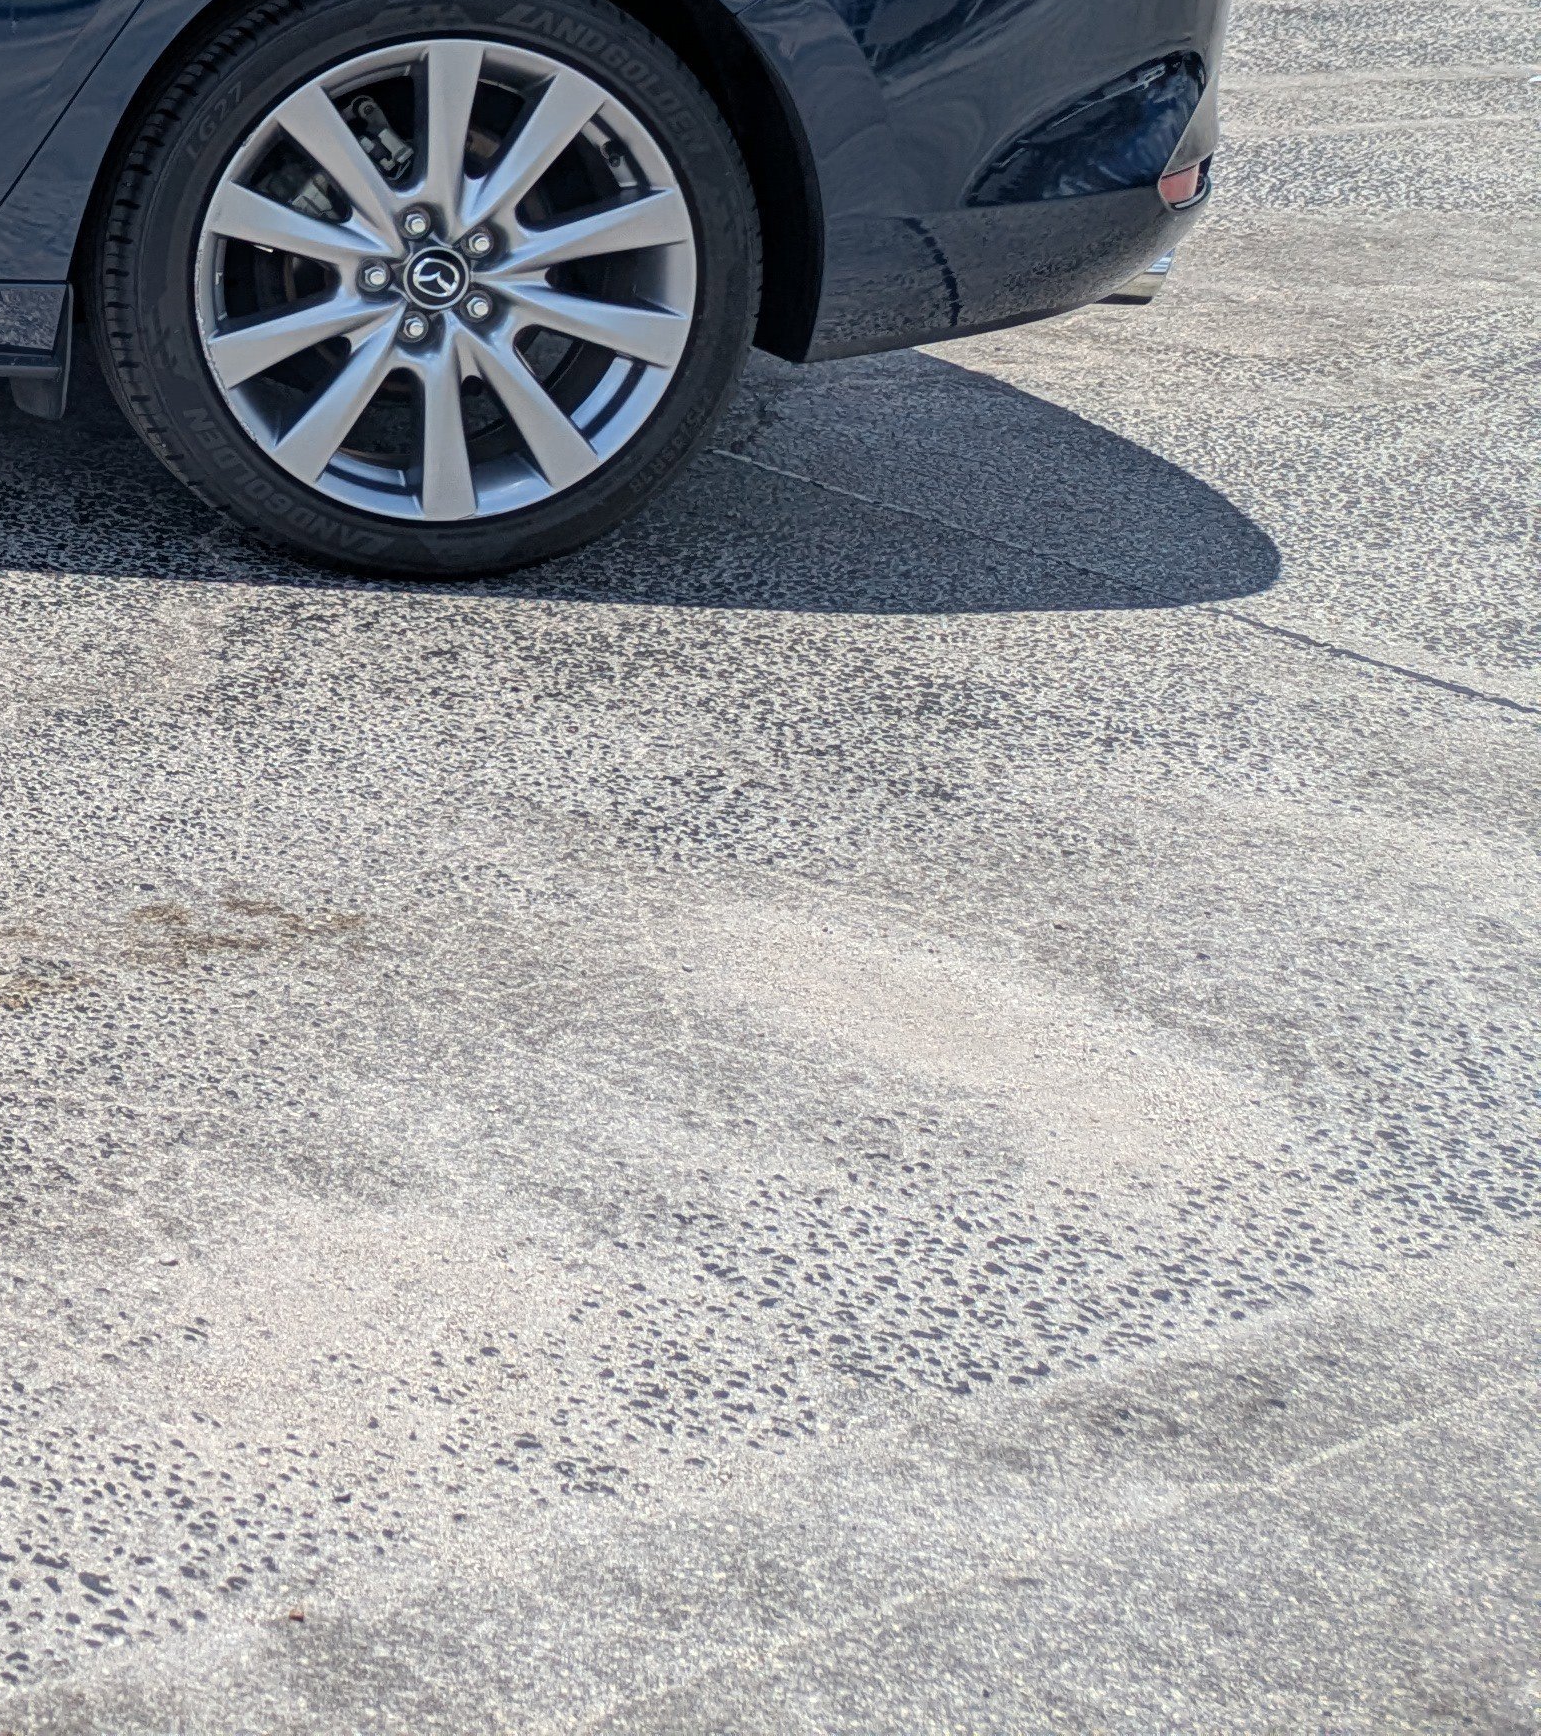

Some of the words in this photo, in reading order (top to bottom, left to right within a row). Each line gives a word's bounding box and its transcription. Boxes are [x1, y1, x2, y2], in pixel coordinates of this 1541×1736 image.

[185, 80, 242, 160] LG27
[496, 2, 710, 156] LANDGOLDEN
[182, 406, 394, 555] LANDGOLDEN
